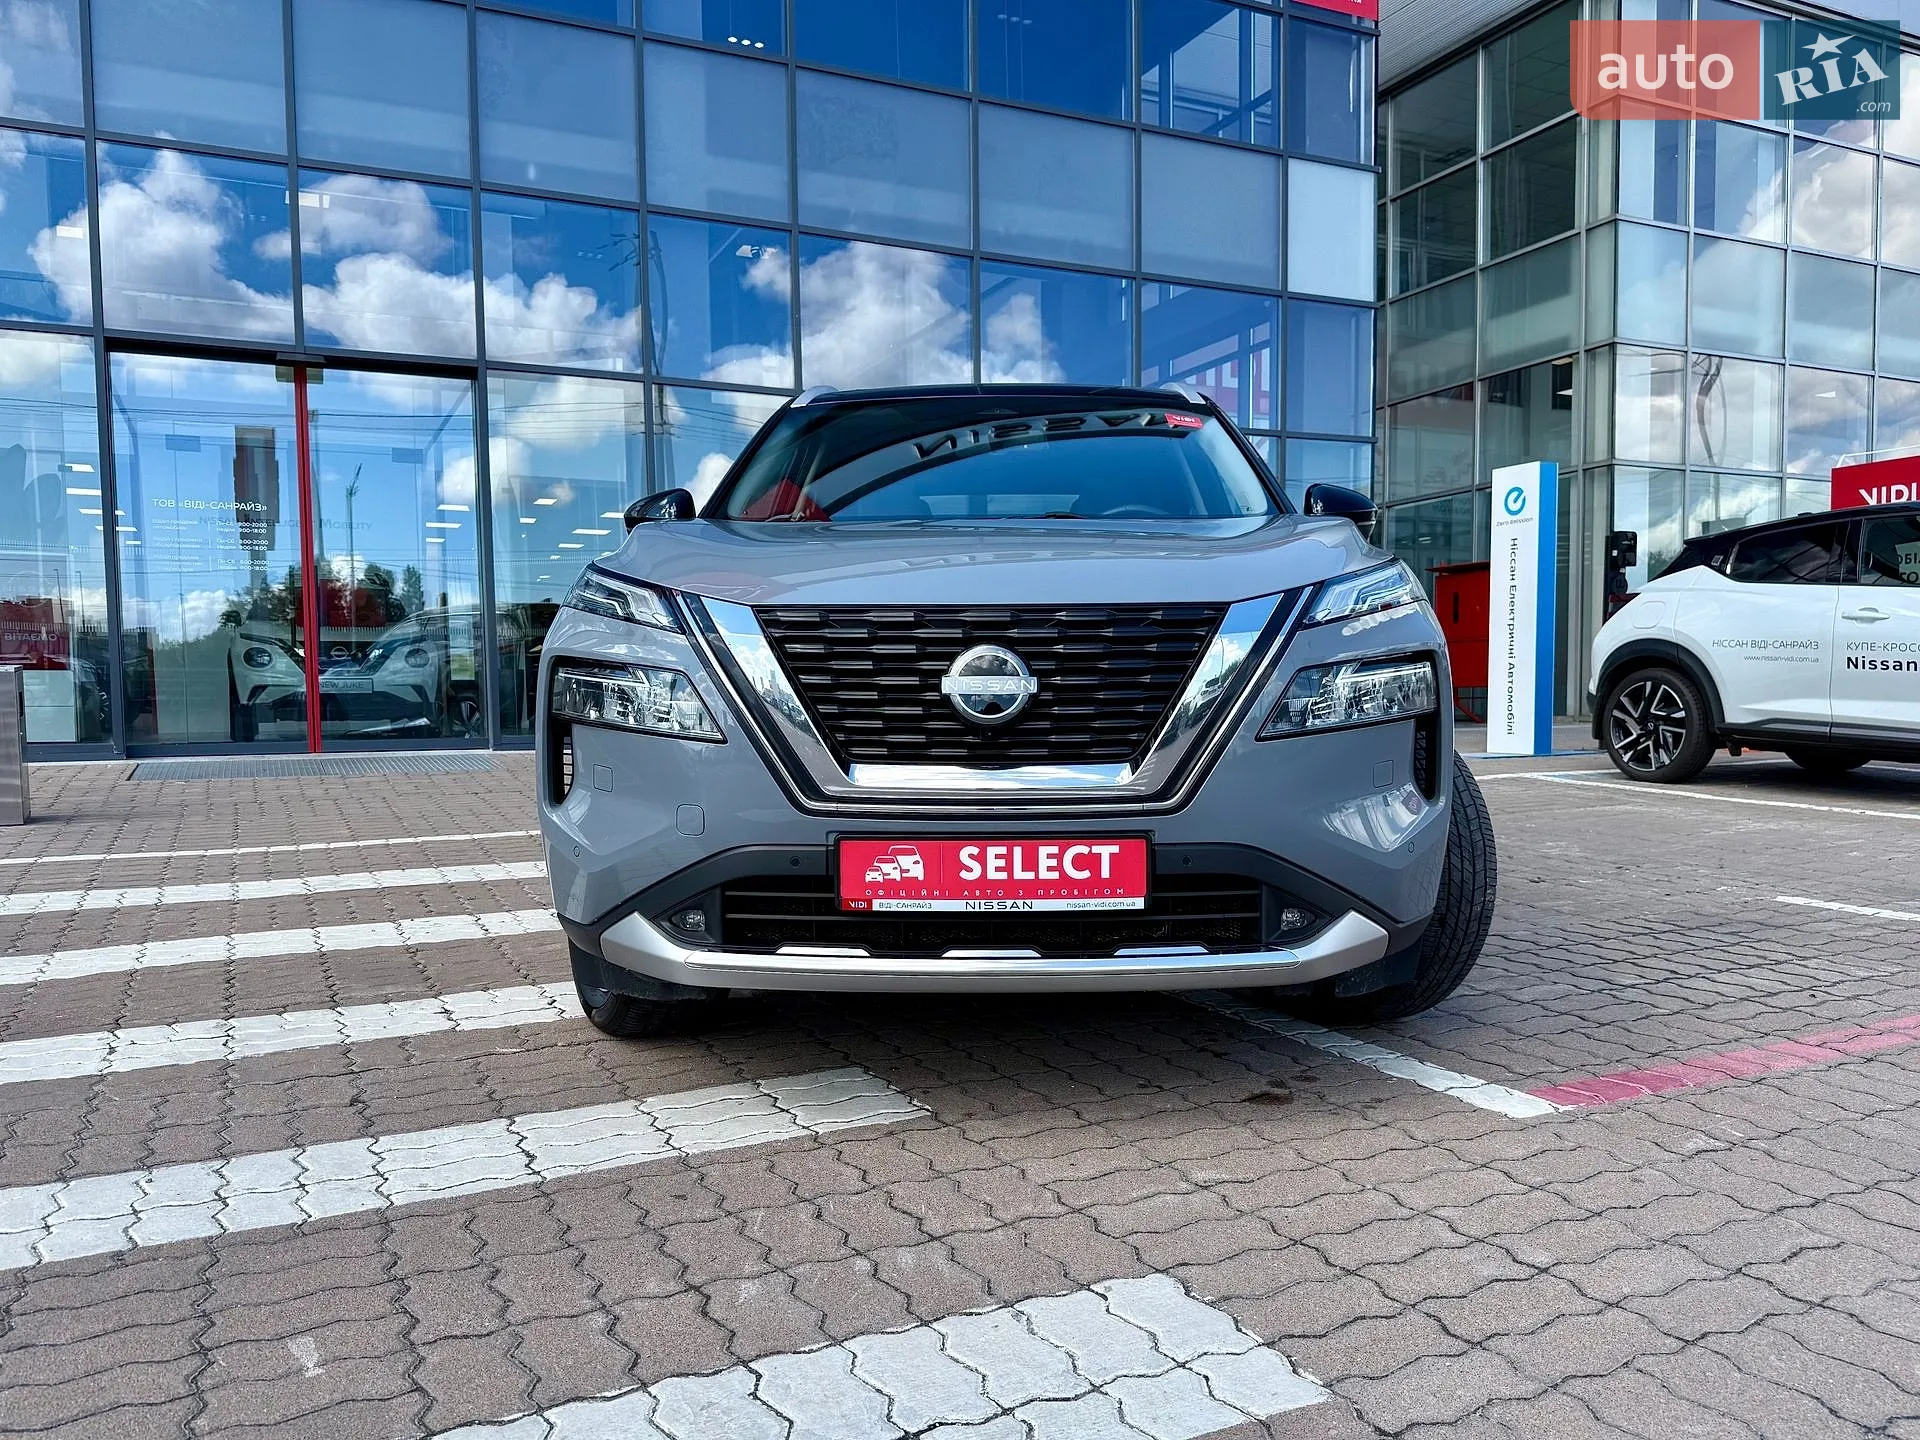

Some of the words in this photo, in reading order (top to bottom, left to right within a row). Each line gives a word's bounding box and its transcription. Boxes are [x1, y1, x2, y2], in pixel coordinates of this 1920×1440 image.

[152, 498, 175, 507] ТОВ
[179, 499, 268, 512] «ВІДІ-САНРАЙЗ»
[1509, 537, 1518, 581] Ніссан
[1506, 584, 1517, 659] Електричні
[1712, 639, 1748, 648] НІССАН
[1750, 639, 1819, 650] ВІДІ-САНРАЙЗ
[1846, 641, 1920, 653] КУПЕ-КРОС
[1744, 655, 1819, 663] www.nissan-vidi.com.ua
[1846, 656, 1918, 672] Nissan
[945, 679, 1035, 691] NISSAN
[1506, 662, 1516, 736] Автомобілі
[959, 844, 1121, 881] SELECT
[864, 888, 950, 897] ОФІЦІЙНІ
[963, 888, 1005, 897] АВТО
[1037, 887, 1125, 897] ПРОБІГОМ
[848, 900, 868, 908] VIDI
[878, 902, 933, 910] ВІДІ-САНРАЙЗ
[965, 901, 1033, 910] NISSAN
[1066, 900, 1137, 909] nissan-vidi.com.ua
